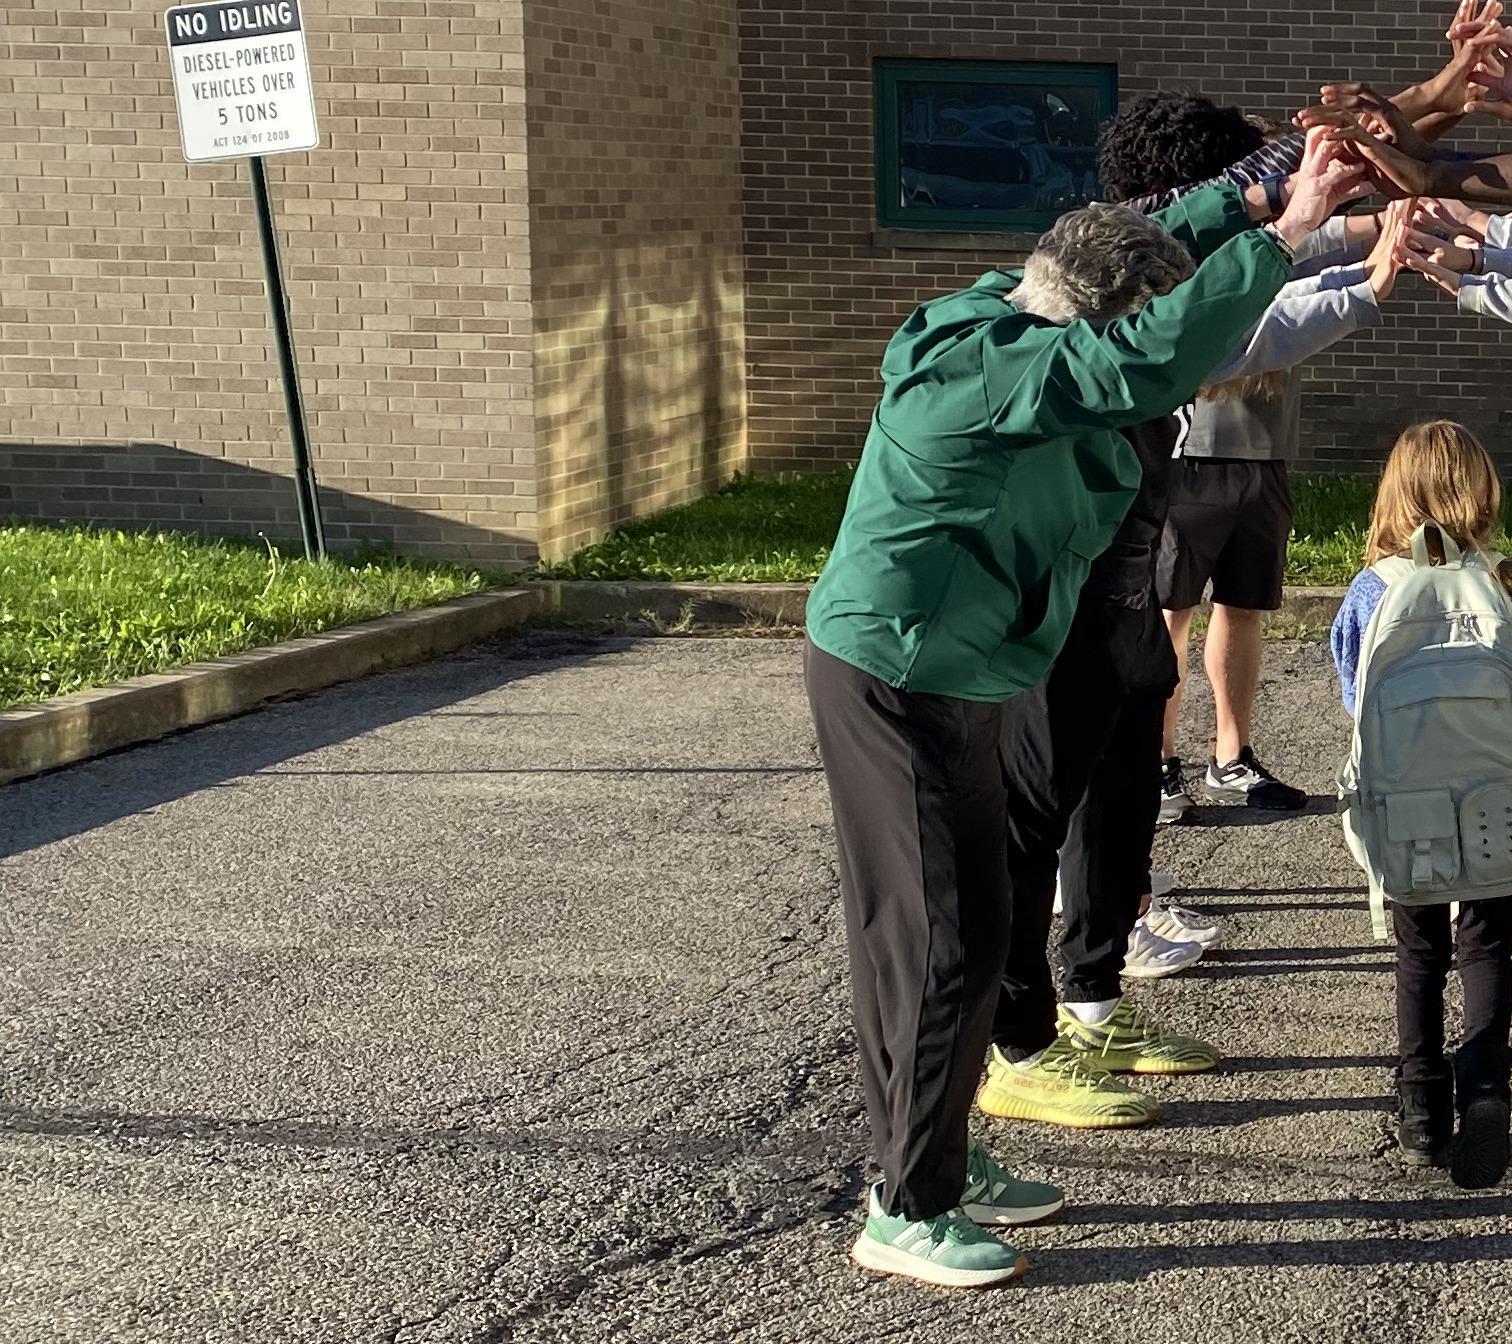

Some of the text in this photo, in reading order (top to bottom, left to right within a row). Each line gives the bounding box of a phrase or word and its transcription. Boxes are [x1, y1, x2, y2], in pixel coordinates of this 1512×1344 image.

[175, 1, 292, 37] NO IDLING
[183, 43, 296, 73] DIESEL-POWERED
[192, 71, 296, 100] VEHICLES OVER
[218, 102, 278, 125] 5 TONS
[213, 136, 228, 148] ACT
[233, 132, 248, 145] 124
[252, 132, 263, 143] OF
